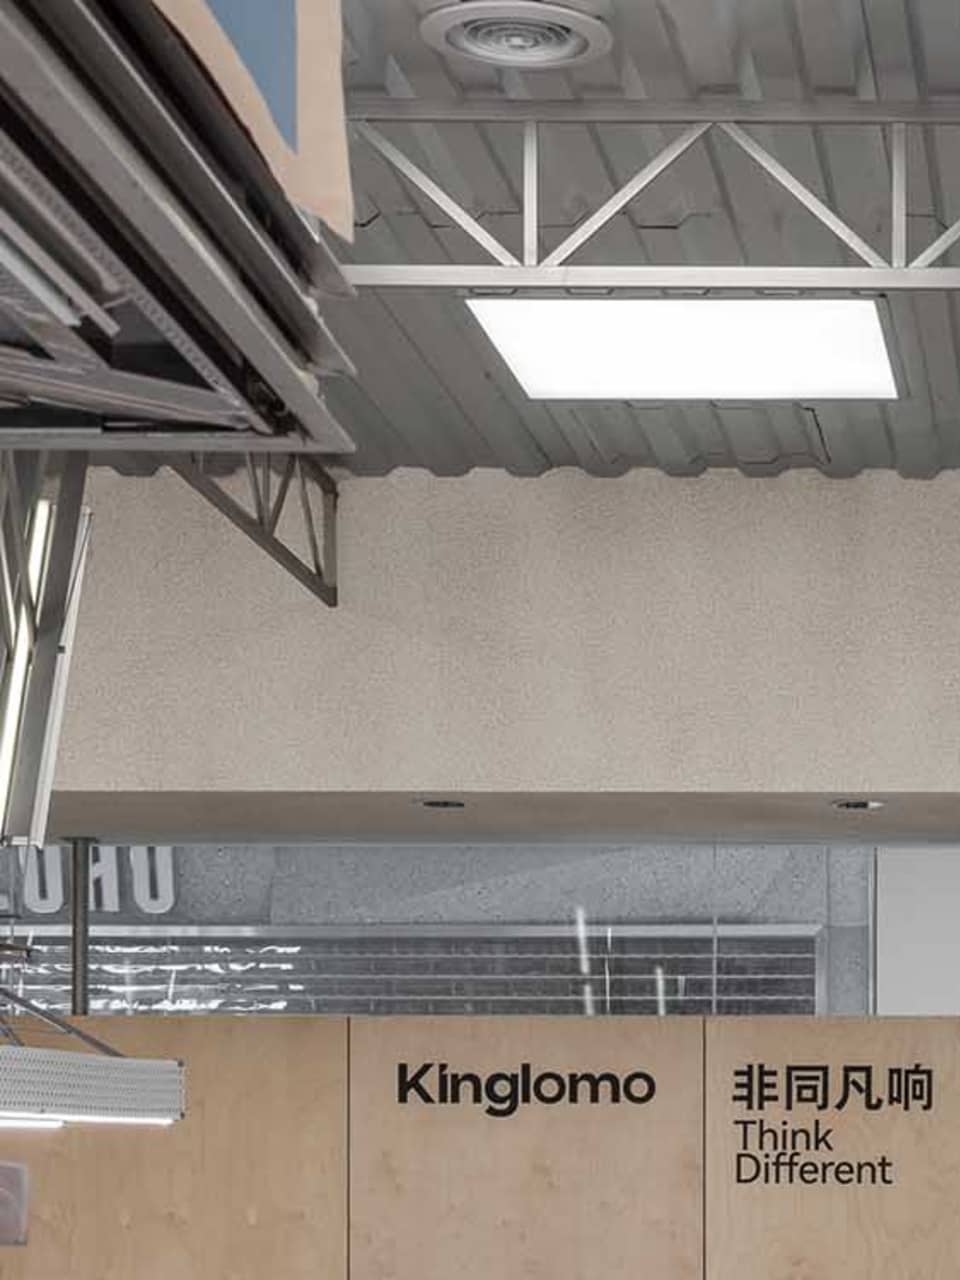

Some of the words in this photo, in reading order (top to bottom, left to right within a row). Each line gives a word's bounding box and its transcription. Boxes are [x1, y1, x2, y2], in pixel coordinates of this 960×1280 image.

[732, 1064, 934, 1112] 非同凡响
[735, 1120, 834, 1151] Think
[736, 1153, 893, 1185] Different
